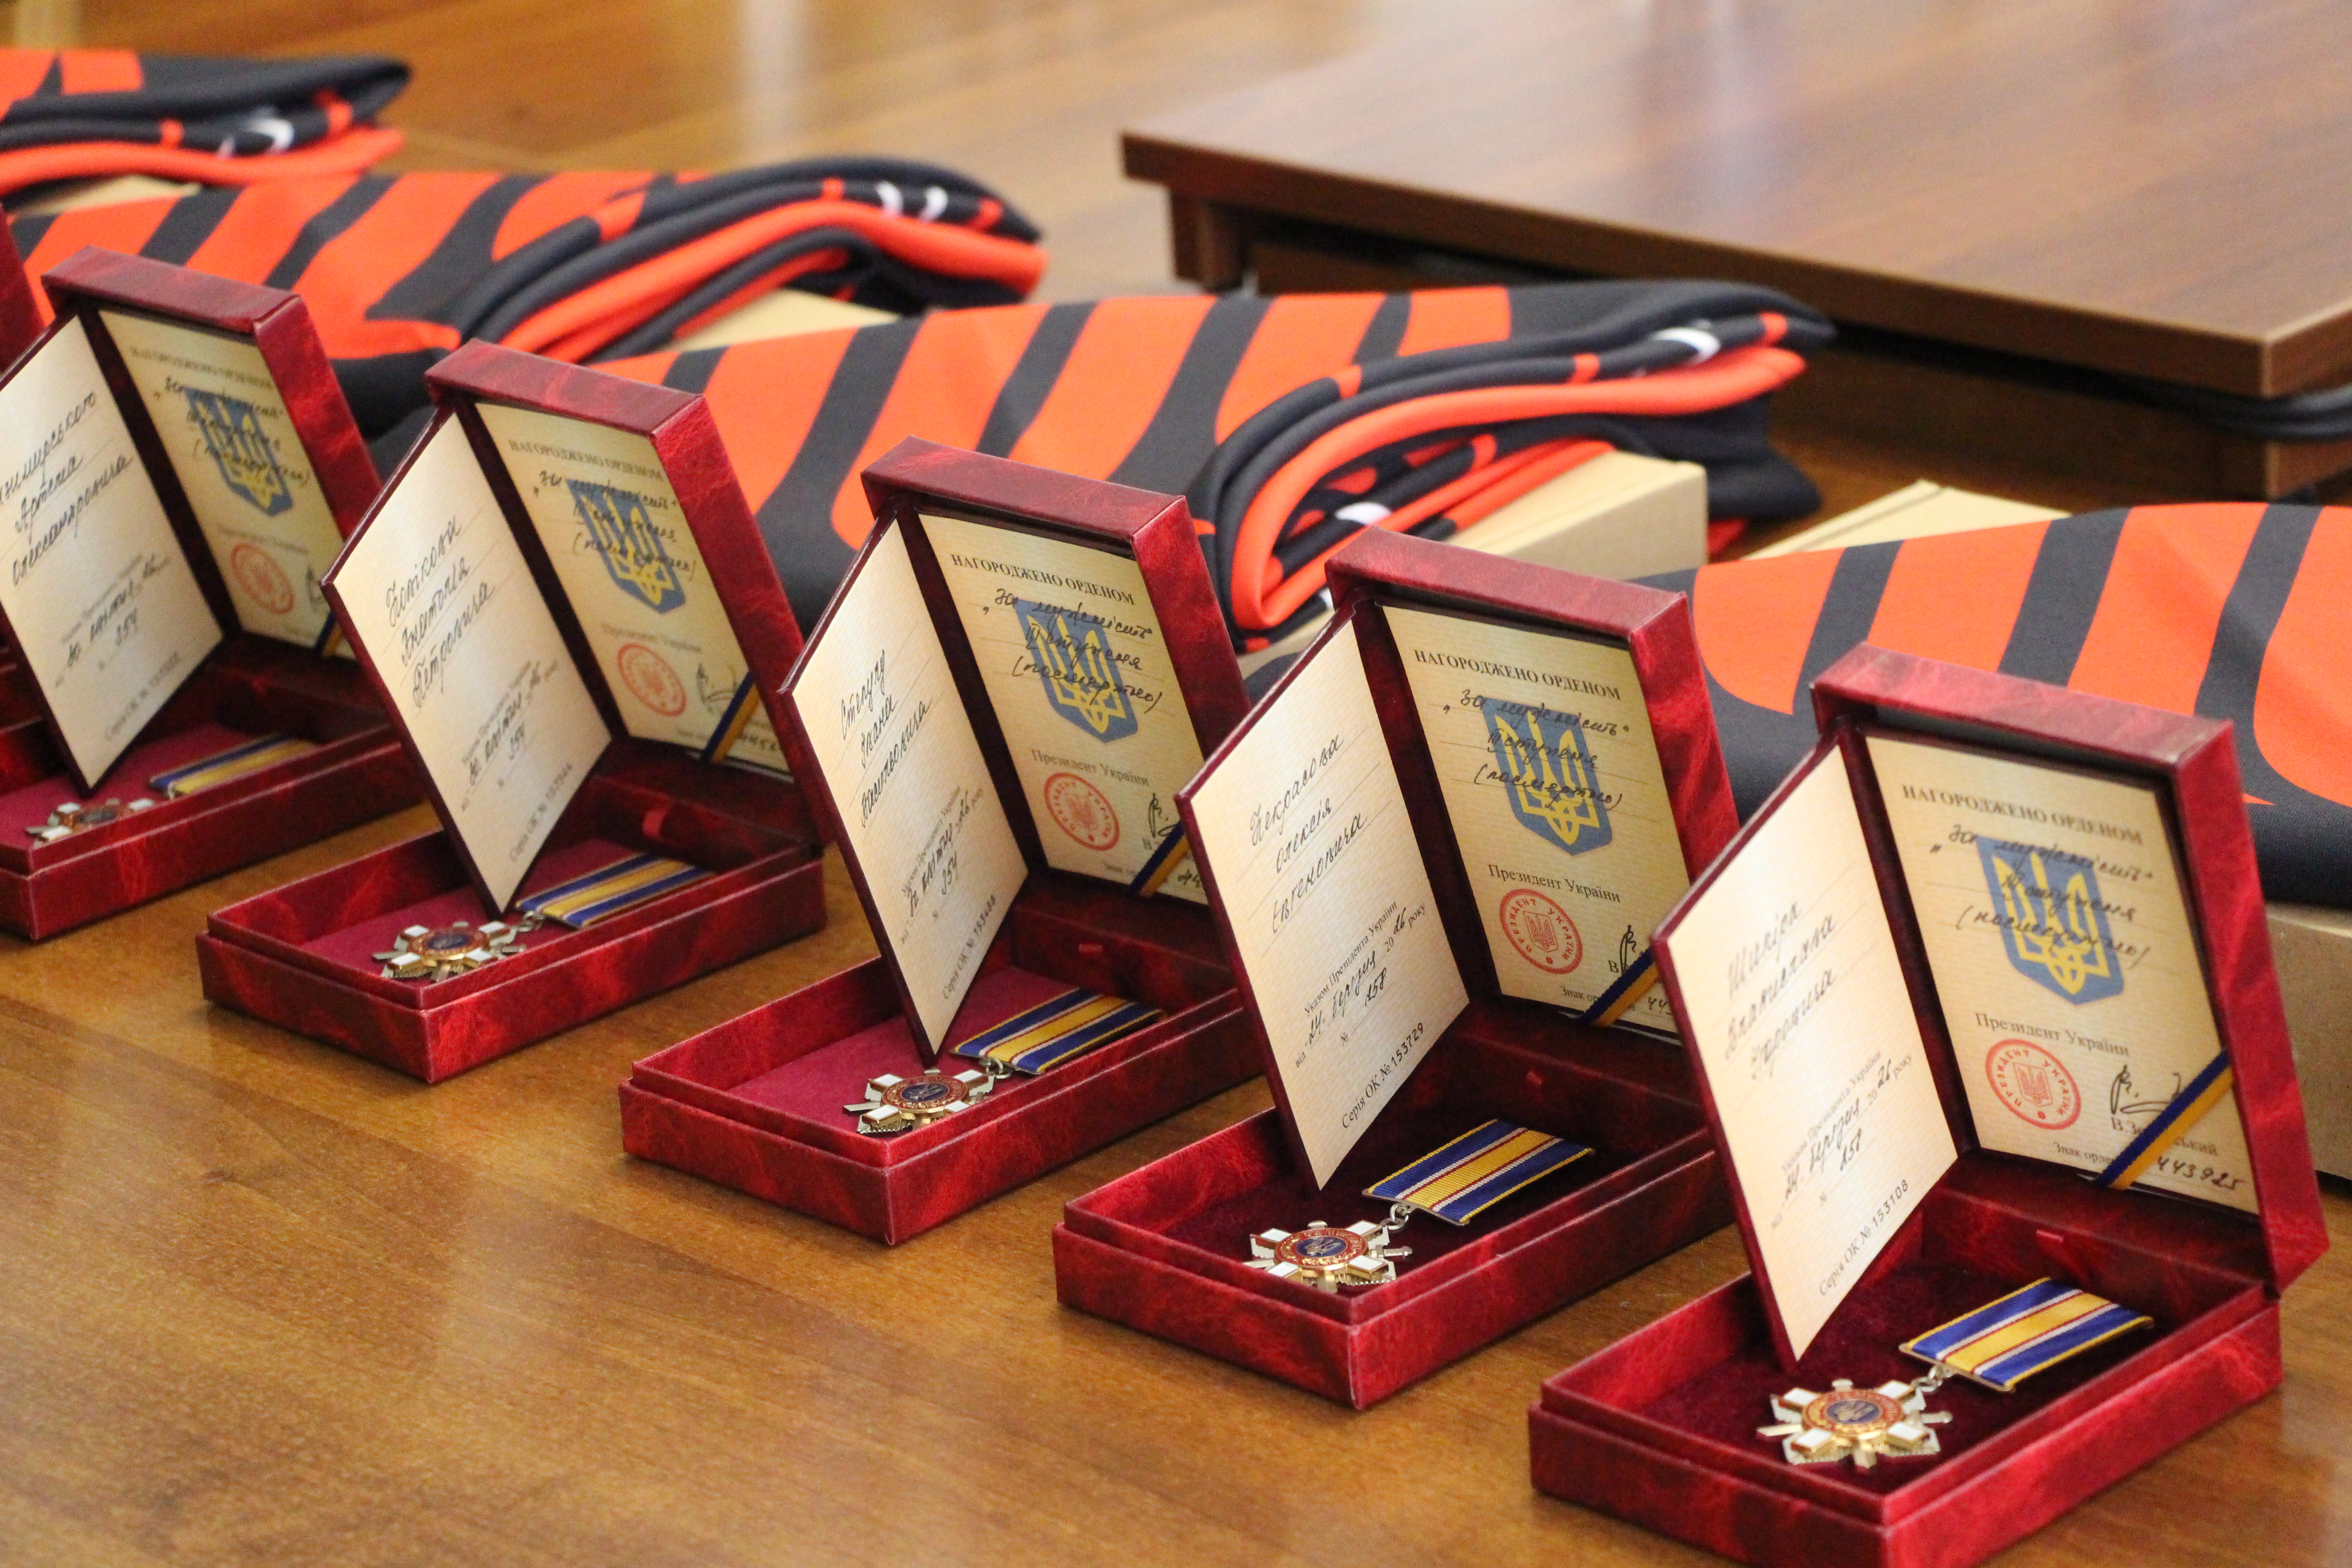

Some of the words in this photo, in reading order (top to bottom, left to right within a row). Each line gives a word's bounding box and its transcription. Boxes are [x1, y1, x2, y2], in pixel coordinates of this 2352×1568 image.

[952, 554, 1063, 587] НАГОРОДЖЕНО
[1065, 578, 1135, 605] ОРДЕНОМ
[1414, 649, 1539, 683] НАГОРОДЖЕНО
[1543, 673, 1621, 701] ОРДЕНОМ
[1031, 750, 1097, 773] Президент
[1100, 763, 1149, 786] України
[1902, 784, 2048, 823] НАГОРОДЖЕНО
[2052, 811, 2143, 845] ОРДЕНОМ
[1488, 864, 1561, 889] Президент
[1565, 878, 1621, 902] України
[1509, 898, 1536, 953] ПРЕЗИДЕНТ
[1304, 984, 1329, 1017] Указом
[1328, 935, 1369, 986] Президента
[1367, 901, 1397, 937] України
[1561, 985, 1584, 999] Знак
[1975, 1012, 2061, 1043] Президент
[2064, 1029, 2130, 1057] України
[1342, 1096, 1366, 1129] Серія
[1391, 1022, 1423, 1067] 153729
[2053, 1141, 2081, 1157] Знак
[1818, 1262, 1844, 1296] Серія
[1872, 1178, 1908, 1226] 153108
